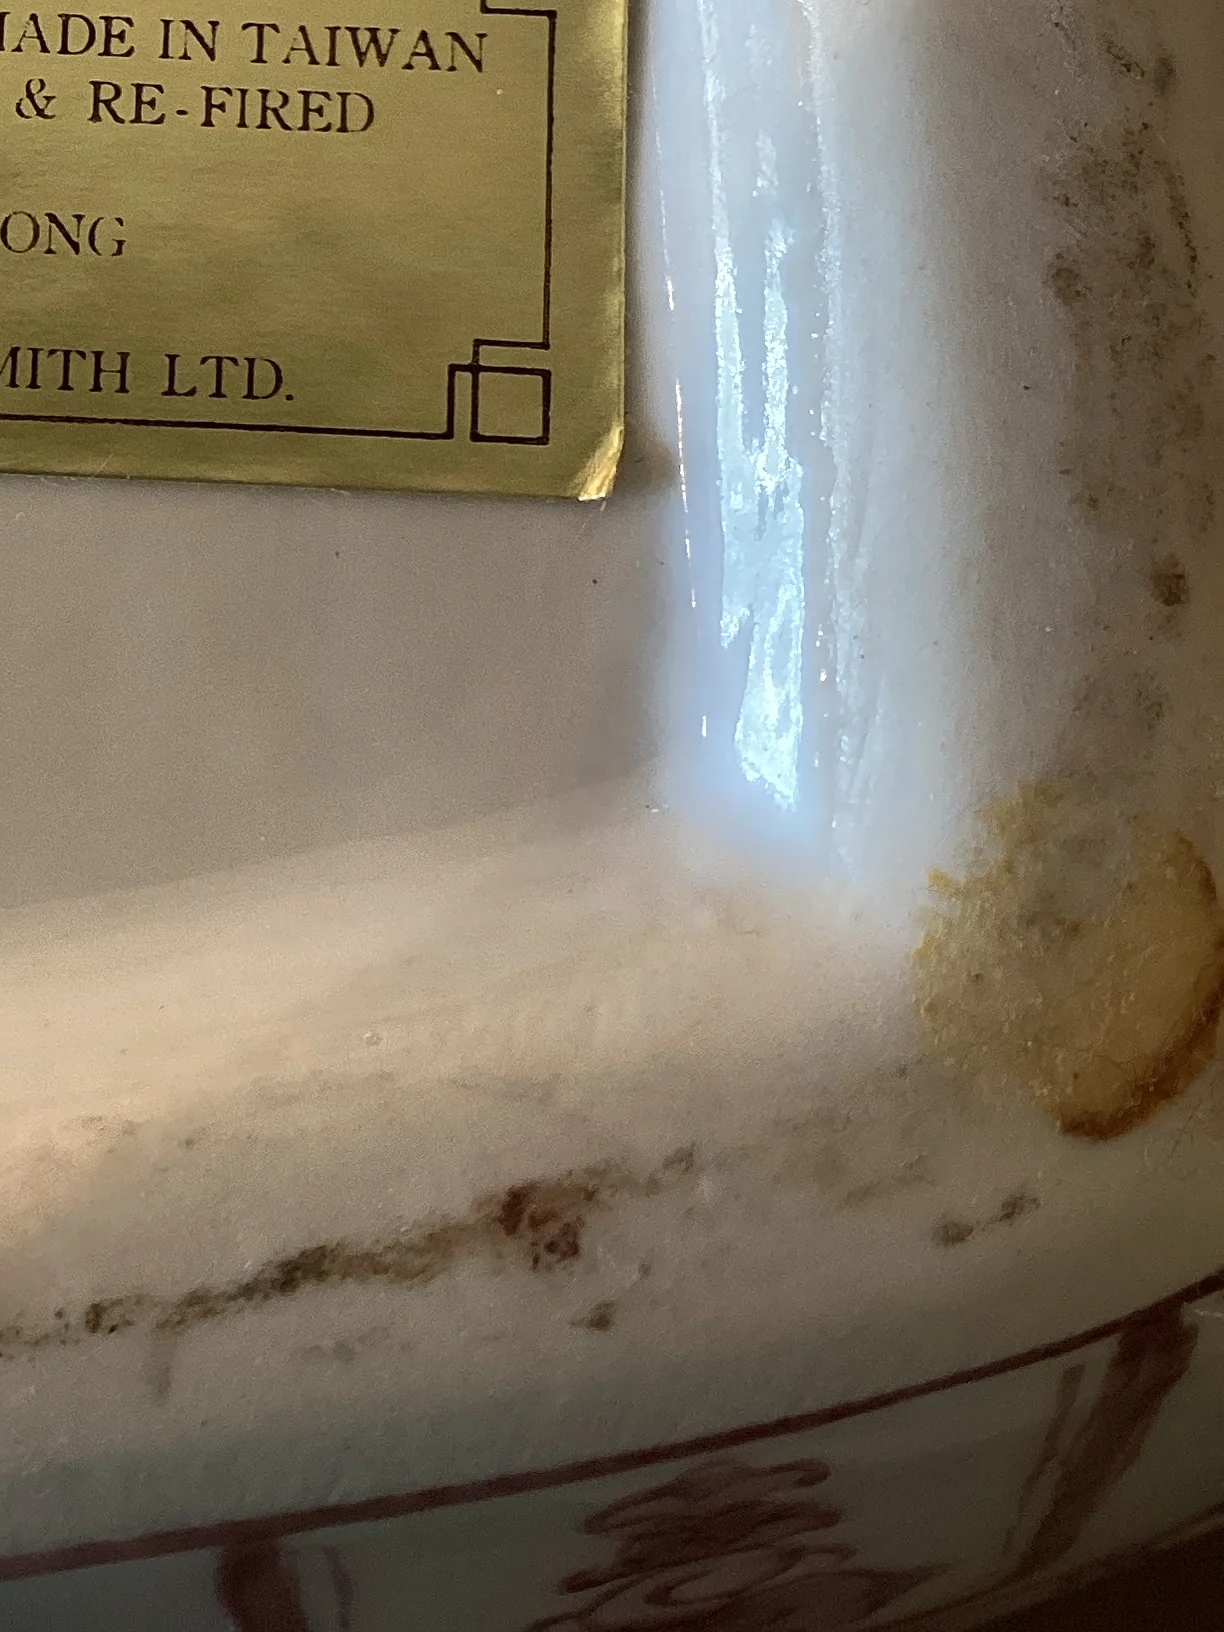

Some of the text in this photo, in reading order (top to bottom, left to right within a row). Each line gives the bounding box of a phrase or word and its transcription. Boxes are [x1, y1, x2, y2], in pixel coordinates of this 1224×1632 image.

[157, 17, 219, 64] IN
[242, 21, 489, 74] TAIWAN
[14, 76, 57, 121] &
[87, 81, 376, 134] RE-FIRED
[160, 353, 296, 403] LTD.
